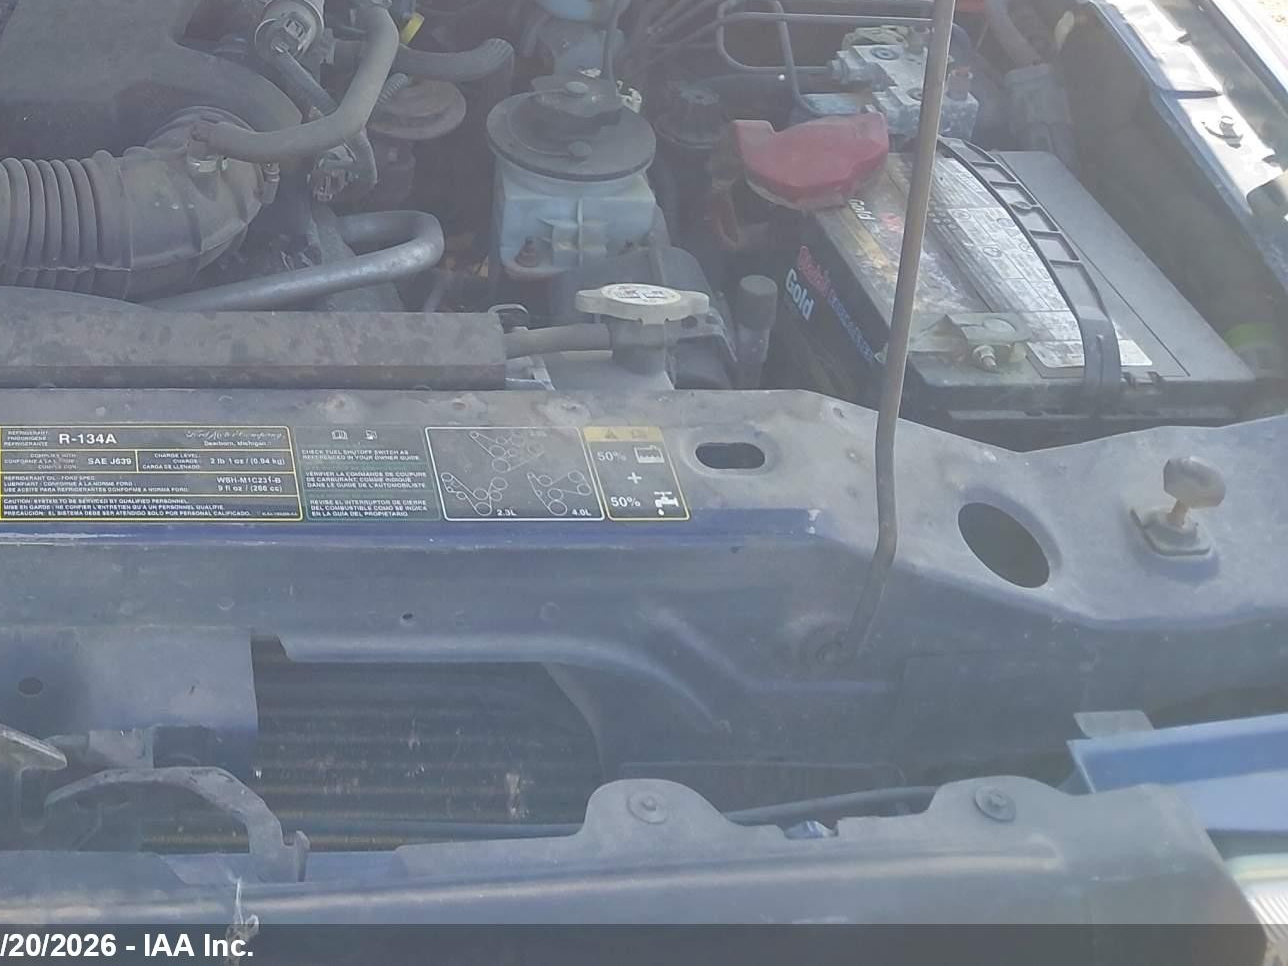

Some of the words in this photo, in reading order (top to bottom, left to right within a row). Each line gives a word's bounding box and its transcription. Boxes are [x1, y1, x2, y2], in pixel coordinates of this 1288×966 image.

[848, 198, 876, 221] Gold
[785, 267, 815, 322] Gold
[59, 434, 116, 444] R-134A
[597, 451, 626, 462] 50%
[610, 496, 642, 508] 50%
